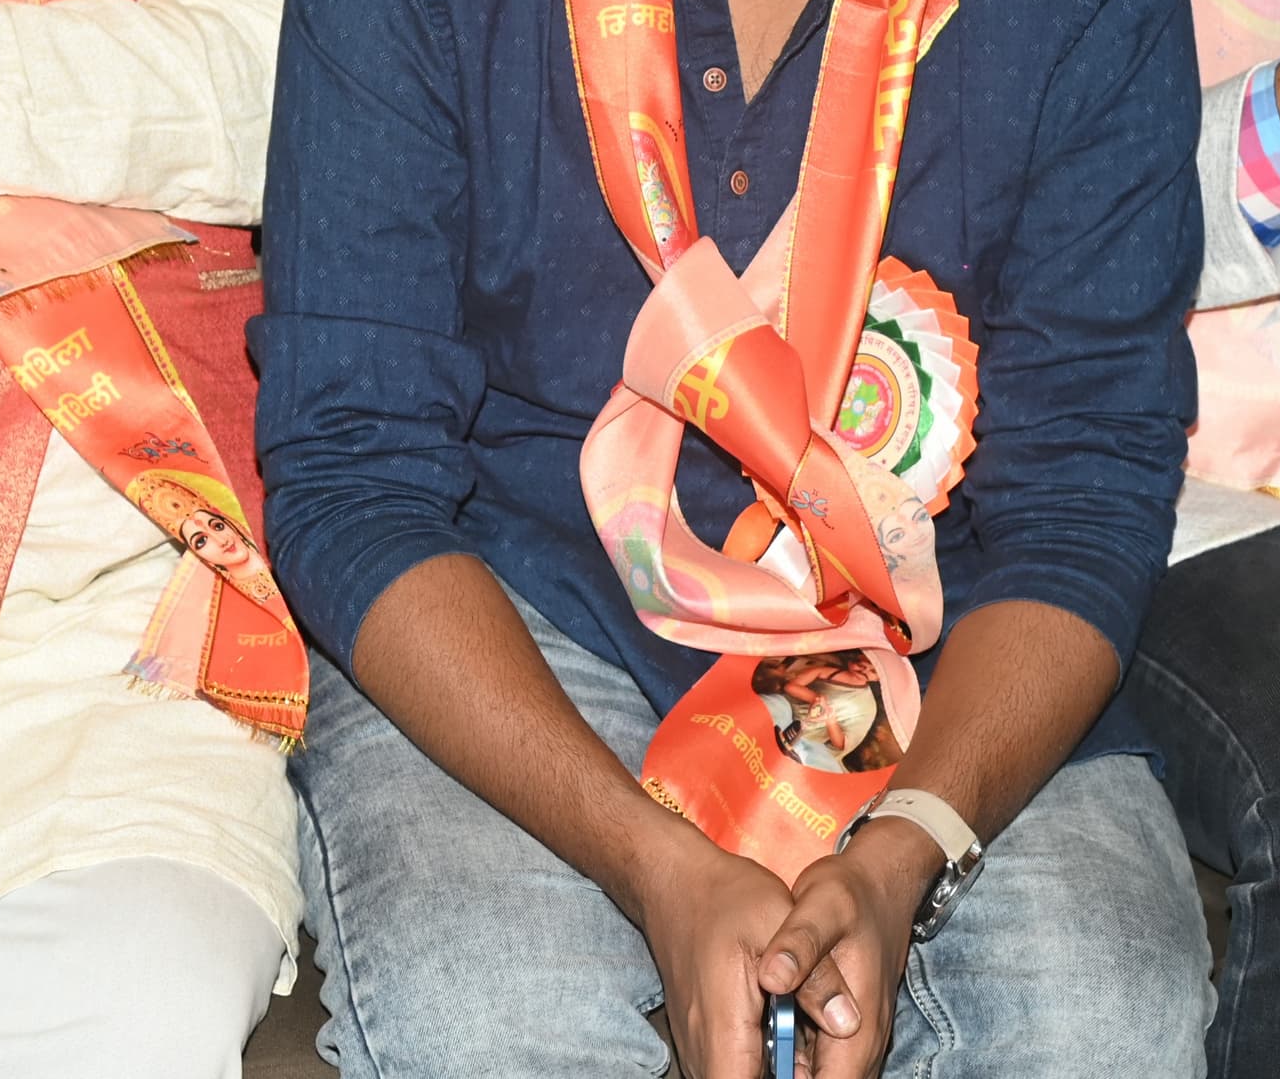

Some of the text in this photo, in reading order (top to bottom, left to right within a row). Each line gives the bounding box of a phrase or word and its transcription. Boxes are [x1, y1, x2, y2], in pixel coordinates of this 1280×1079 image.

[690, 713, 736, 736] कवि
[732, 728, 775, 790] कोकिल
[769, 781, 839, 840] विद्यापति
